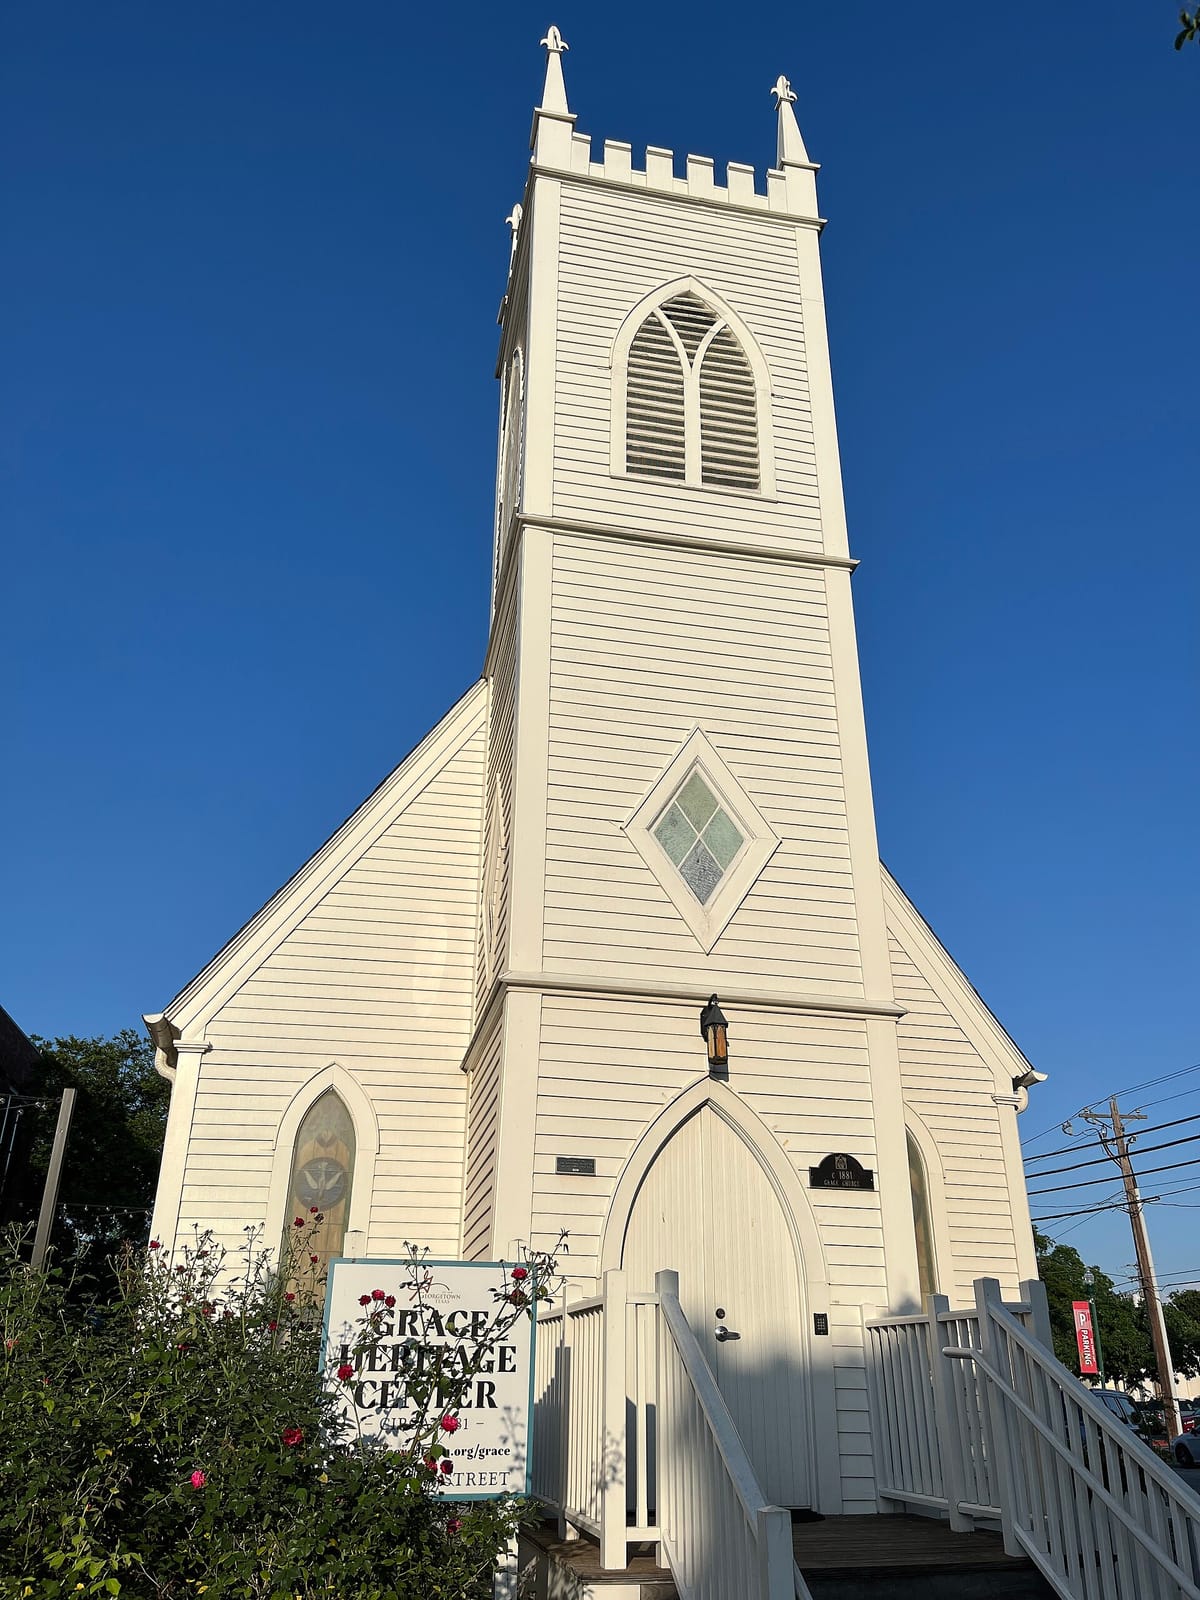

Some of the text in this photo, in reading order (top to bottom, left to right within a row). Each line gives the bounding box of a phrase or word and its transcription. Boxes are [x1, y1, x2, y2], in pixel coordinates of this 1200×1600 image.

[838, 1171, 852, 1180] 1881
[371, 1308, 489, 1338] GRACE
[1080, 1313, 1086, 1326] P
[339, 1343, 518, 1373] HERITAGE
[1081, 1330, 1092, 1365] PARKING
[354, 1379, 498, 1409] CENTER
[443, 1471, 511, 1487] STREET
